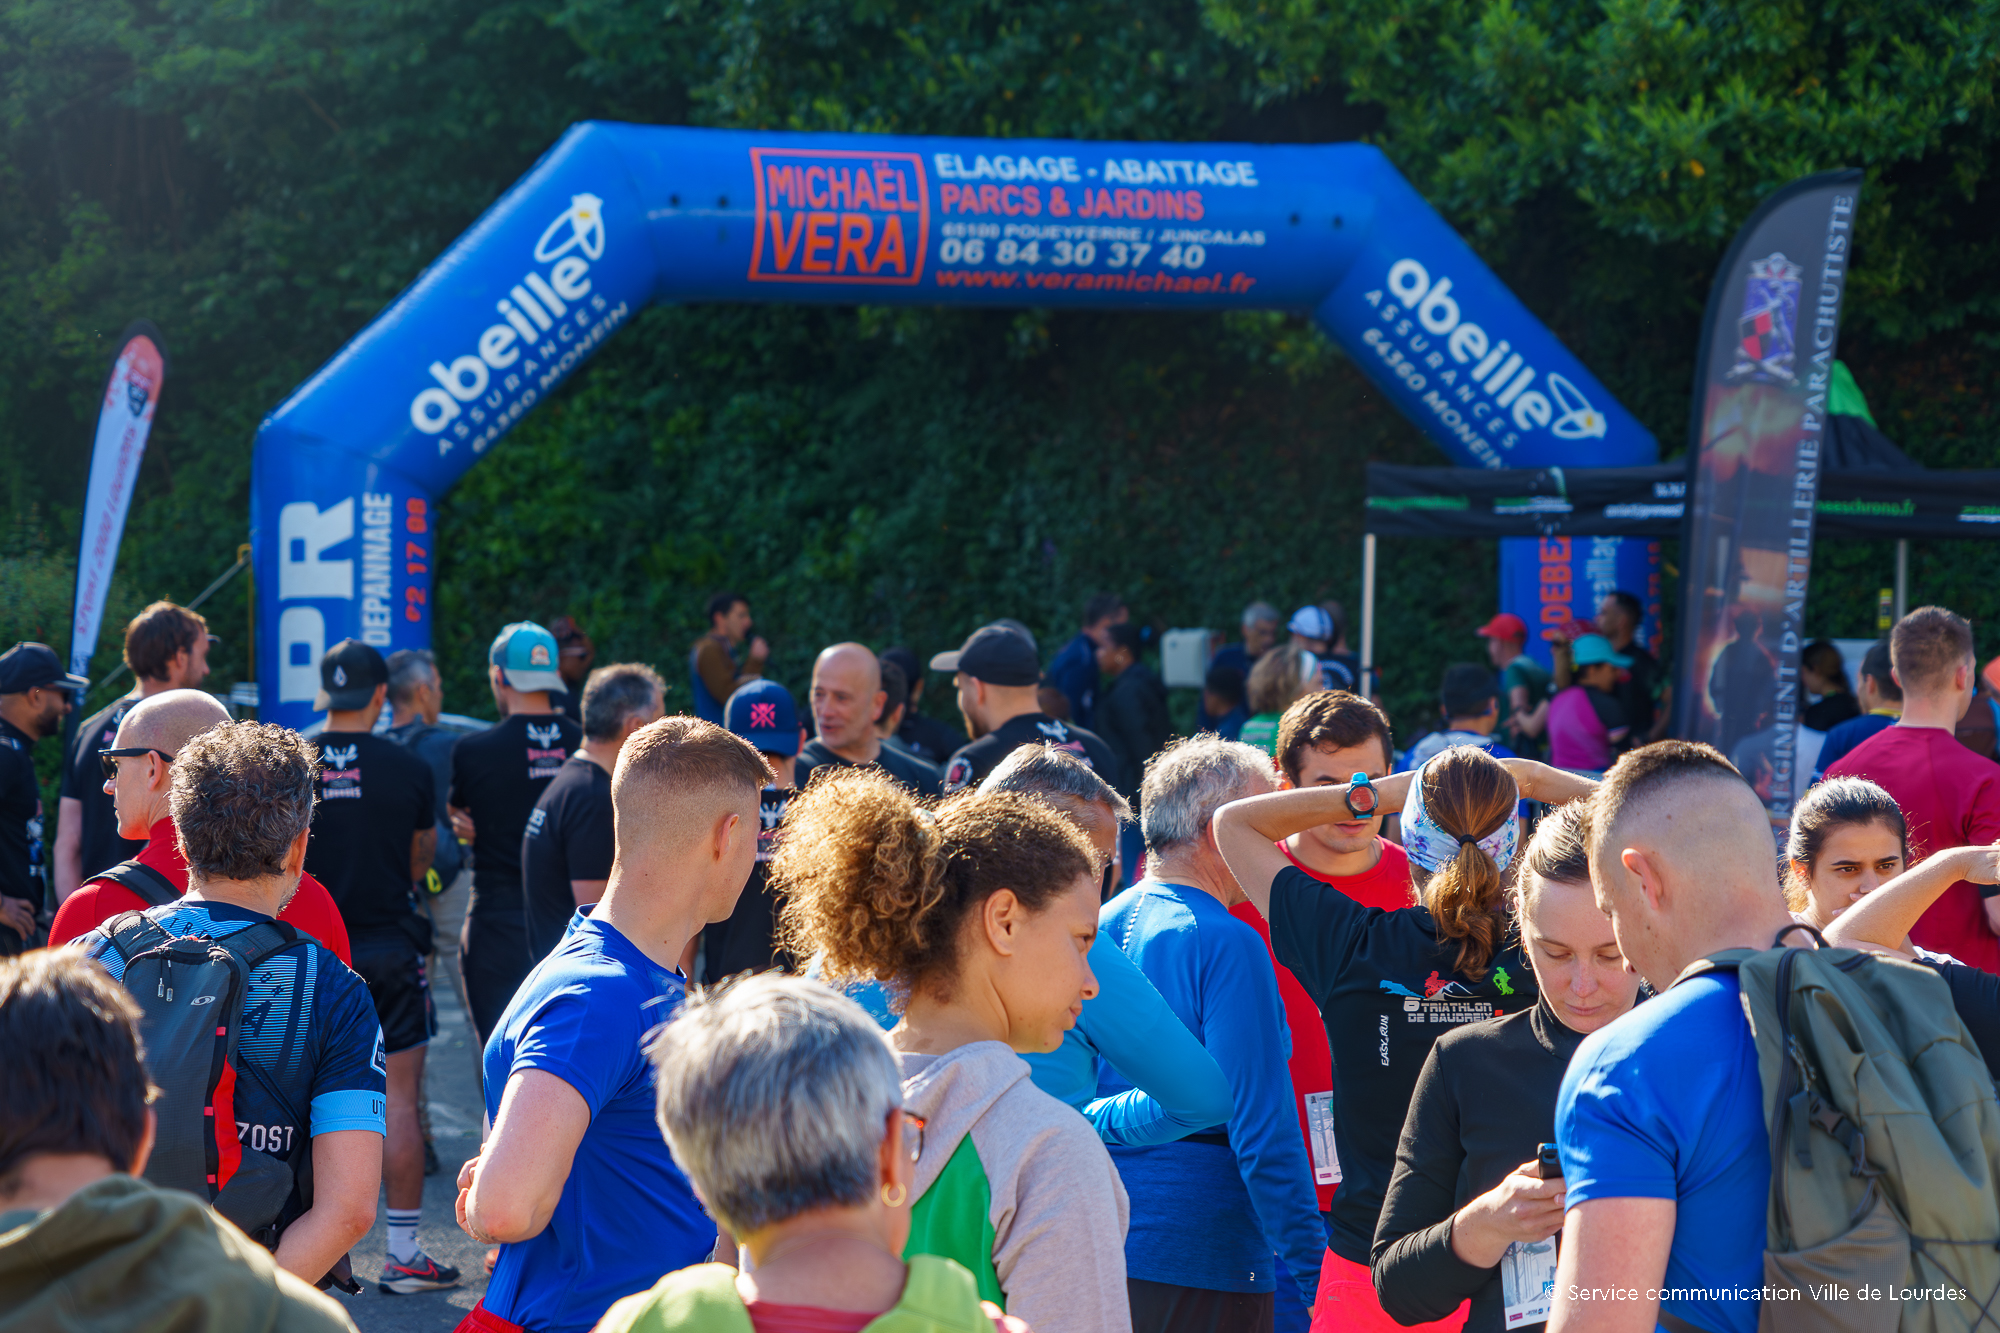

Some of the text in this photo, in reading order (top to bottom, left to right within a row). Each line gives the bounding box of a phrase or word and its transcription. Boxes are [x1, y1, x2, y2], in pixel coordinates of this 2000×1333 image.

[767, 160, 919, 212] MICHAËL
[934, 153, 1081, 183] ELAGAGE
[1104, 159, 1259, 187] ABATTAGE
[940, 183, 1205, 221] PARCS & JARDINS
[768, 211, 907, 274] VERA
[940, 238, 1206, 269] 06 84 30 37 40
[1159, 228, 1267, 246] JUNCALAS
[935, 269, 1257, 294] www.veramichael.fr
[1803, 194, 1853, 432] PARACHUTISTE
[410, 256, 592, 434] abeille
[539, 301, 628, 389] MONEIN
[1362, 328, 1427, 391] 64360
[1364, 289, 1520, 449] ASSURANCES
[1387, 257, 1552, 431] abeille
[438, 293, 607, 456] ASSURANCES
[362, 492, 392, 648] DEPANNAGE
[405, 540, 427, 576] 17
[1408, 1013, 1425, 1023] DE
[1421, 1003, 1492, 1013] TRIATHLON
[1379, 1014, 1389, 1066] EASY RUN
